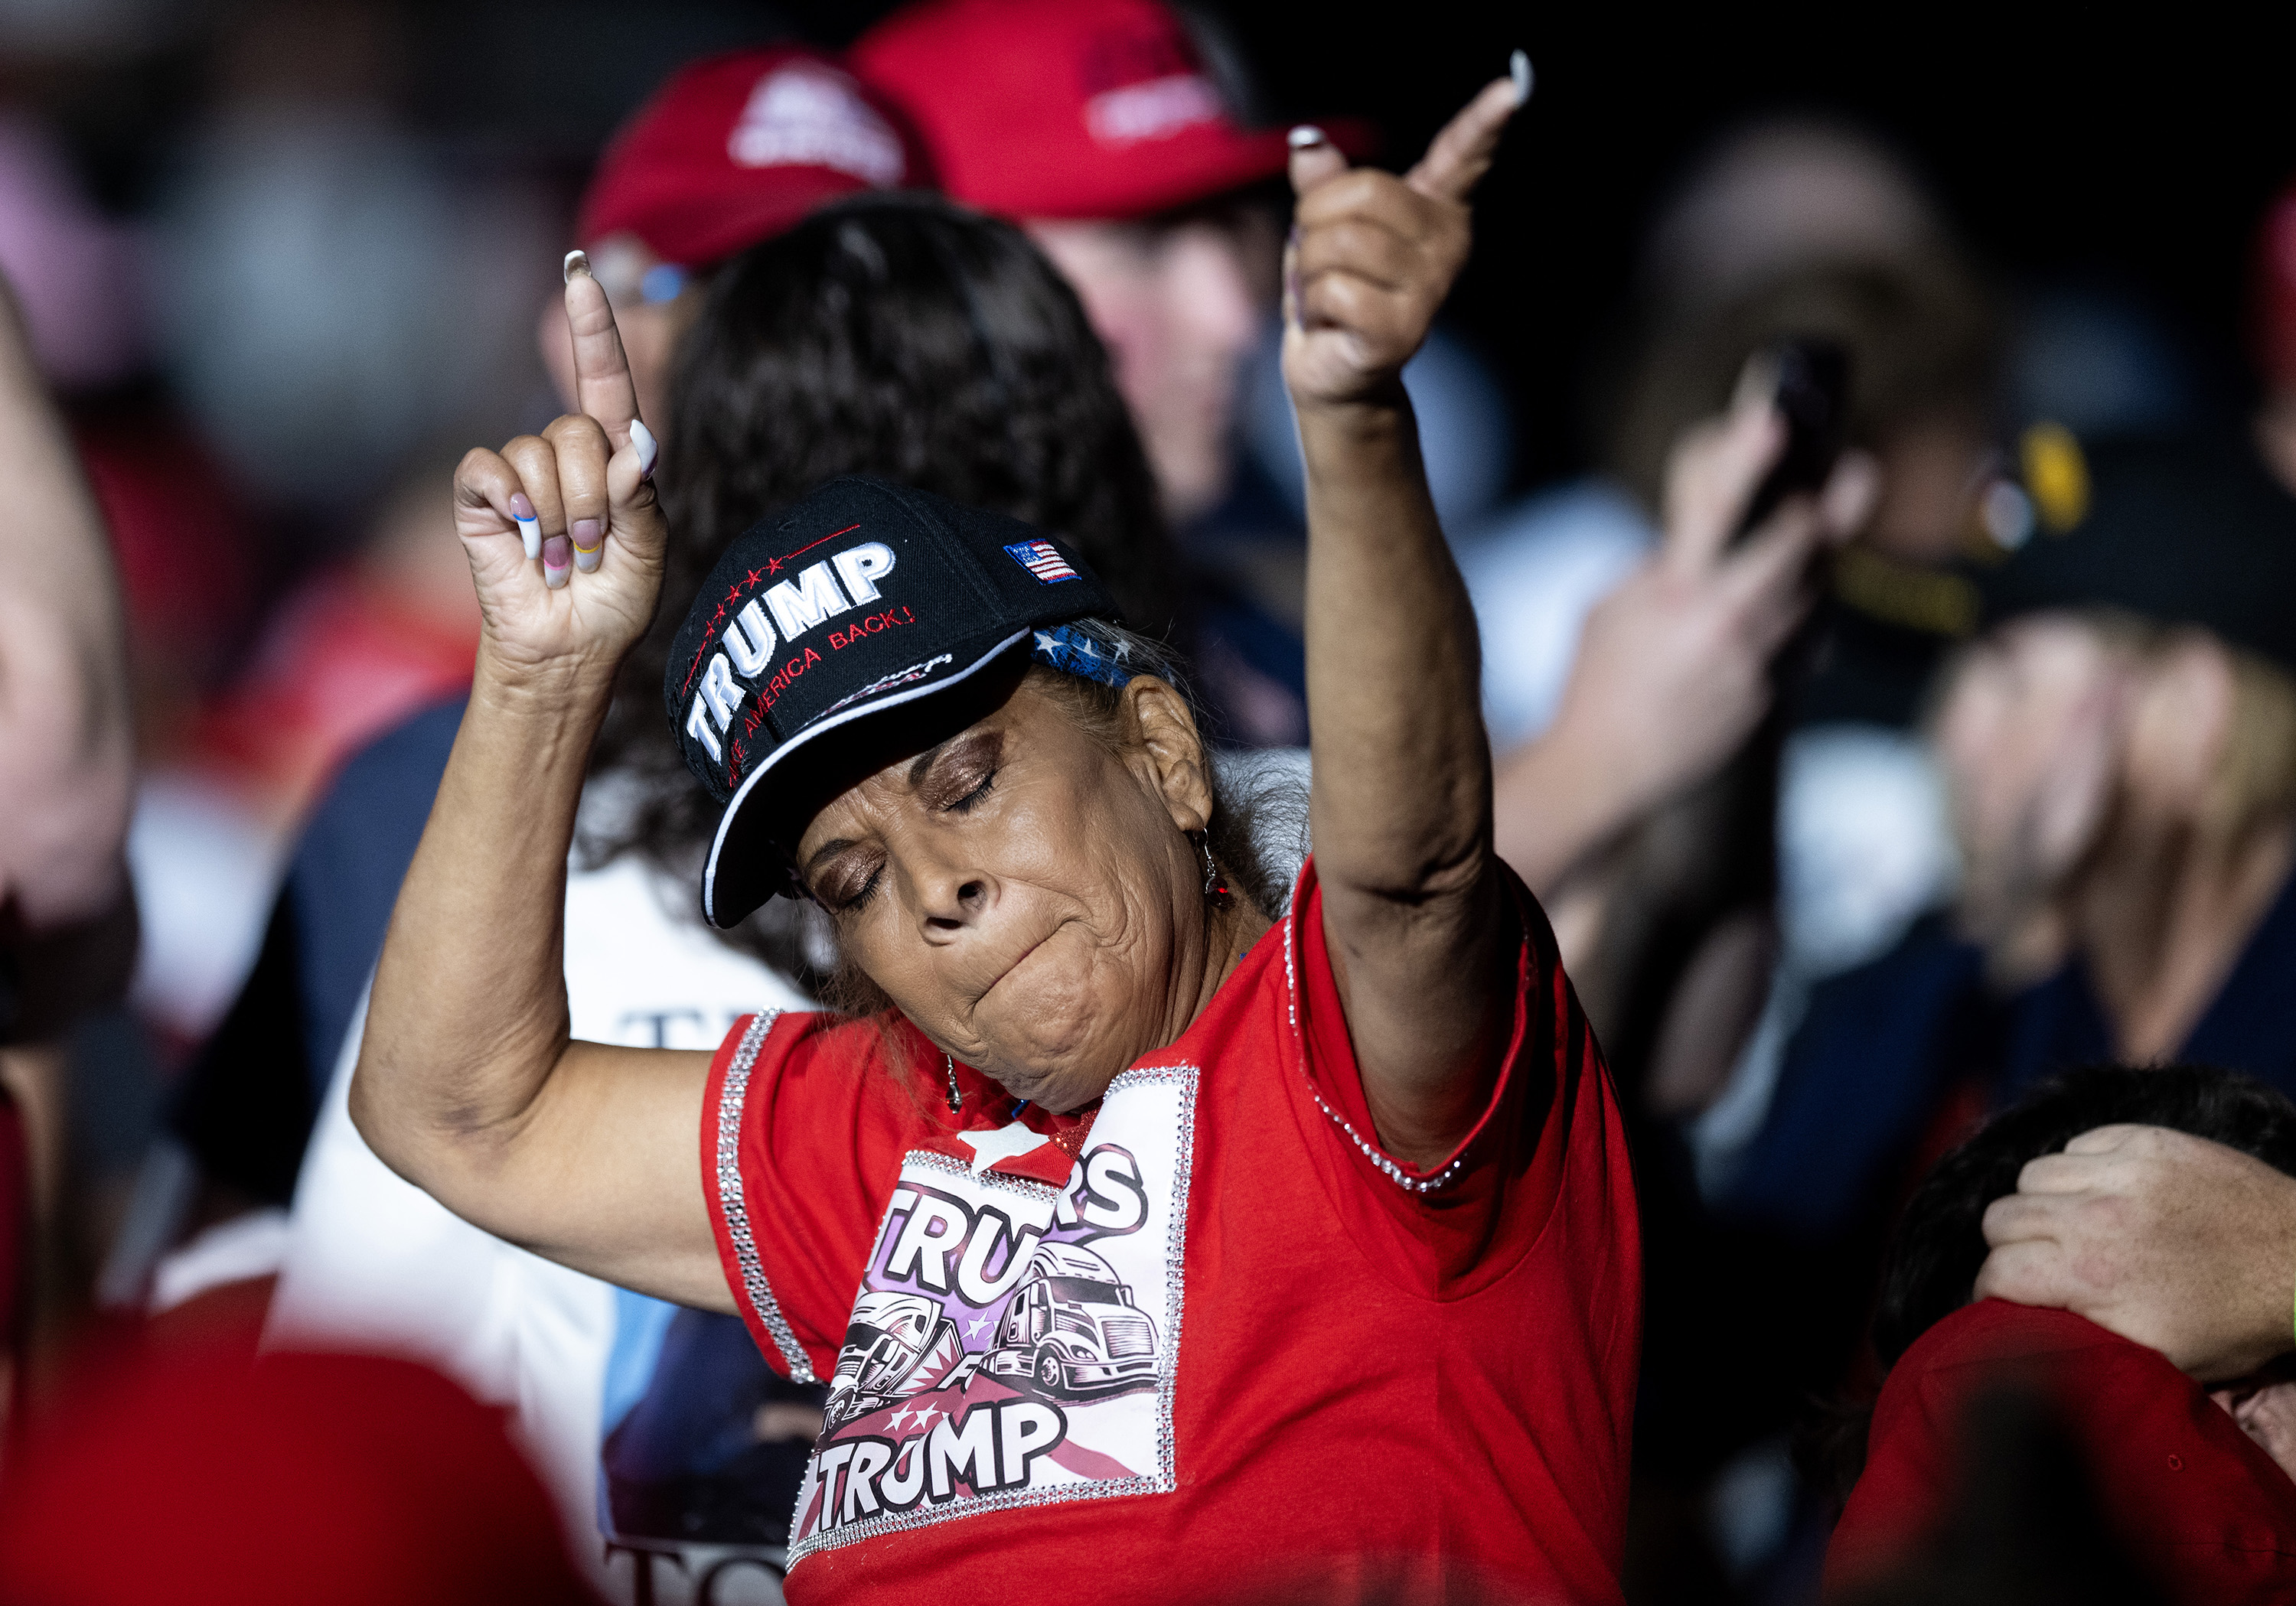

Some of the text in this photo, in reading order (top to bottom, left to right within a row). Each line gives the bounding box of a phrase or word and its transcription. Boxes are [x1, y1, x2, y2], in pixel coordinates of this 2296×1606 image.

[687, 542, 895, 766] TRUMP
[744, 647, 821, 739] AMERICA
[828, 606, 916, 650] BACK!
[816, 1400, 1068, 1532] TRUMP
